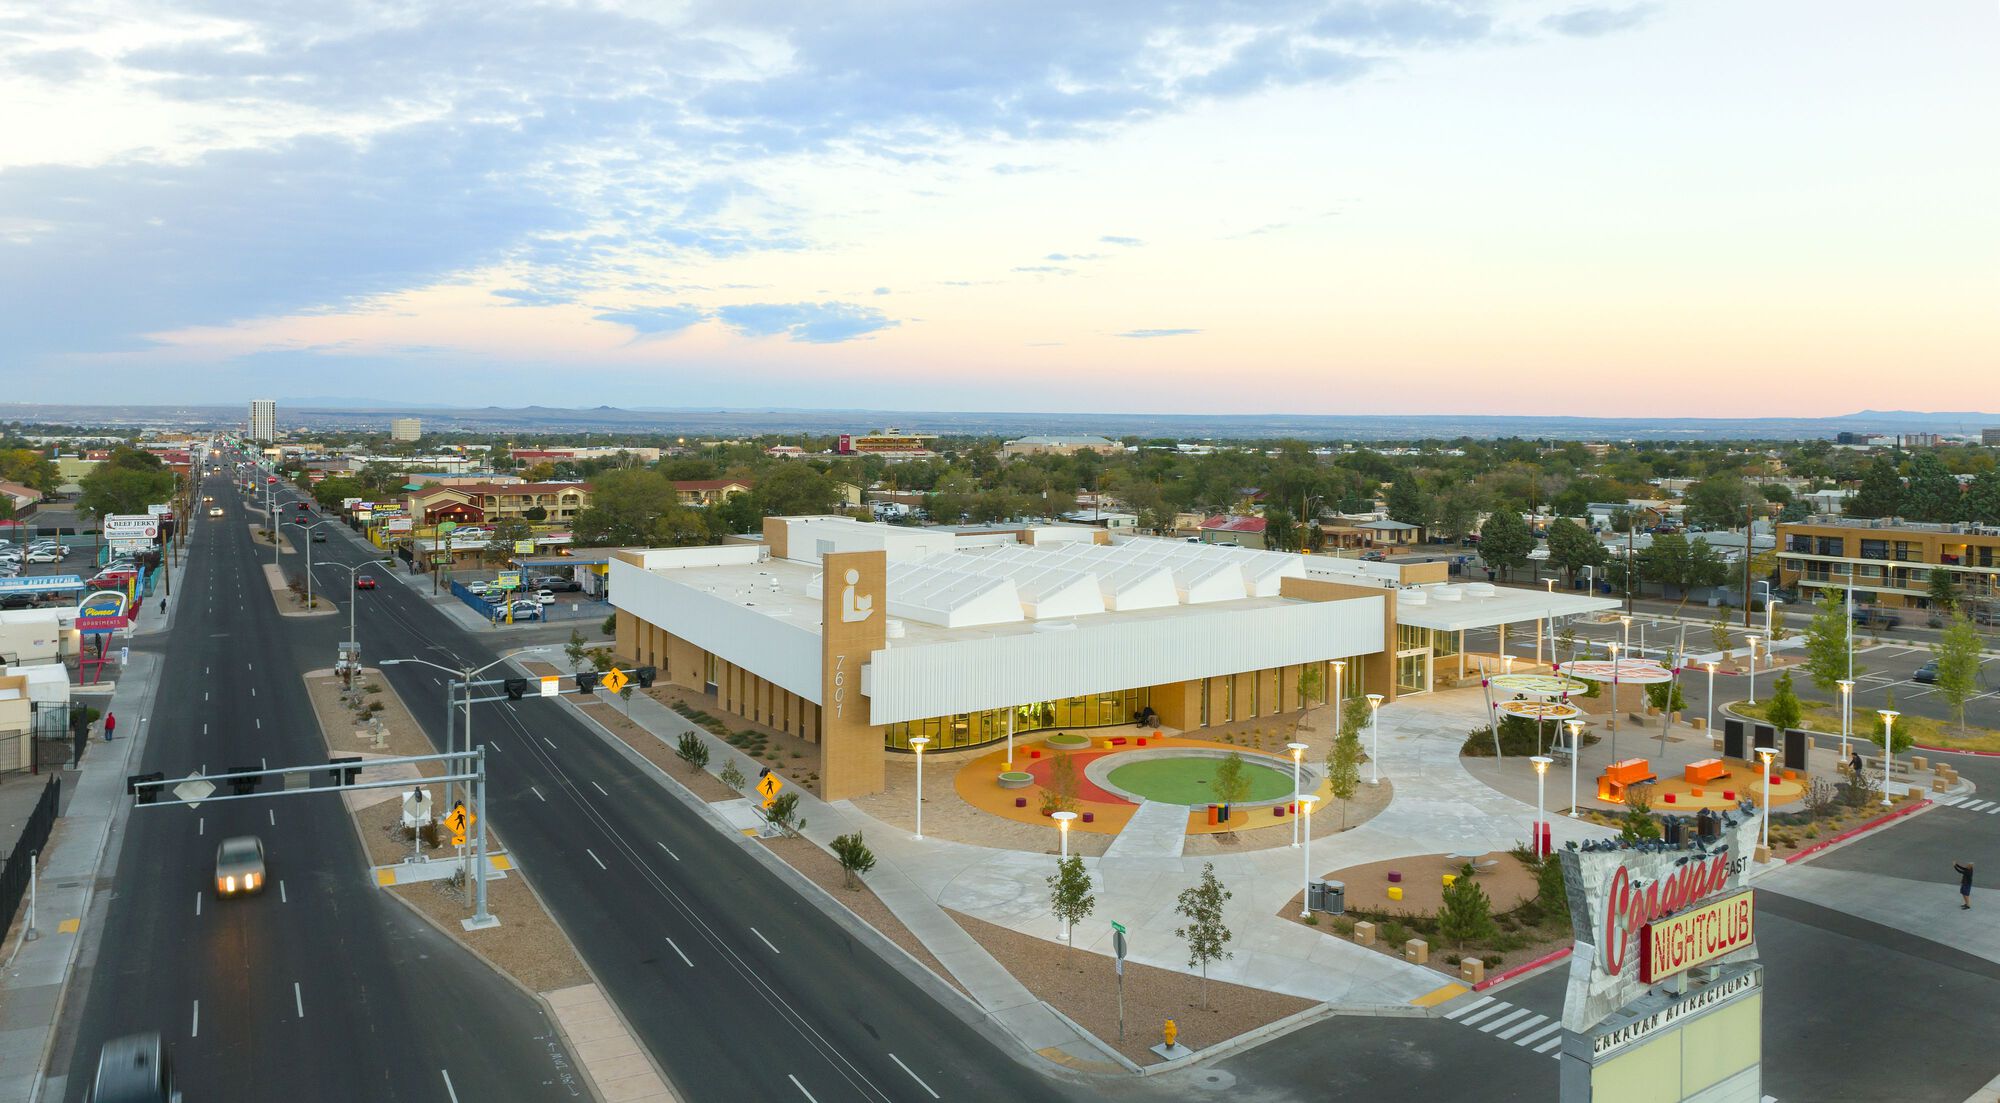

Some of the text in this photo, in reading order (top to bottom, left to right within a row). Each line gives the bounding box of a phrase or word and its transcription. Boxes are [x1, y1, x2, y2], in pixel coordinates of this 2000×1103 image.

[85, 607, 116, 616] Pioneer
[835, 656, 845, 718] 7601
[1606, 852, 1728, 976] Caravan
[1653, 900, 1750, 975] NIGHTCLUB
